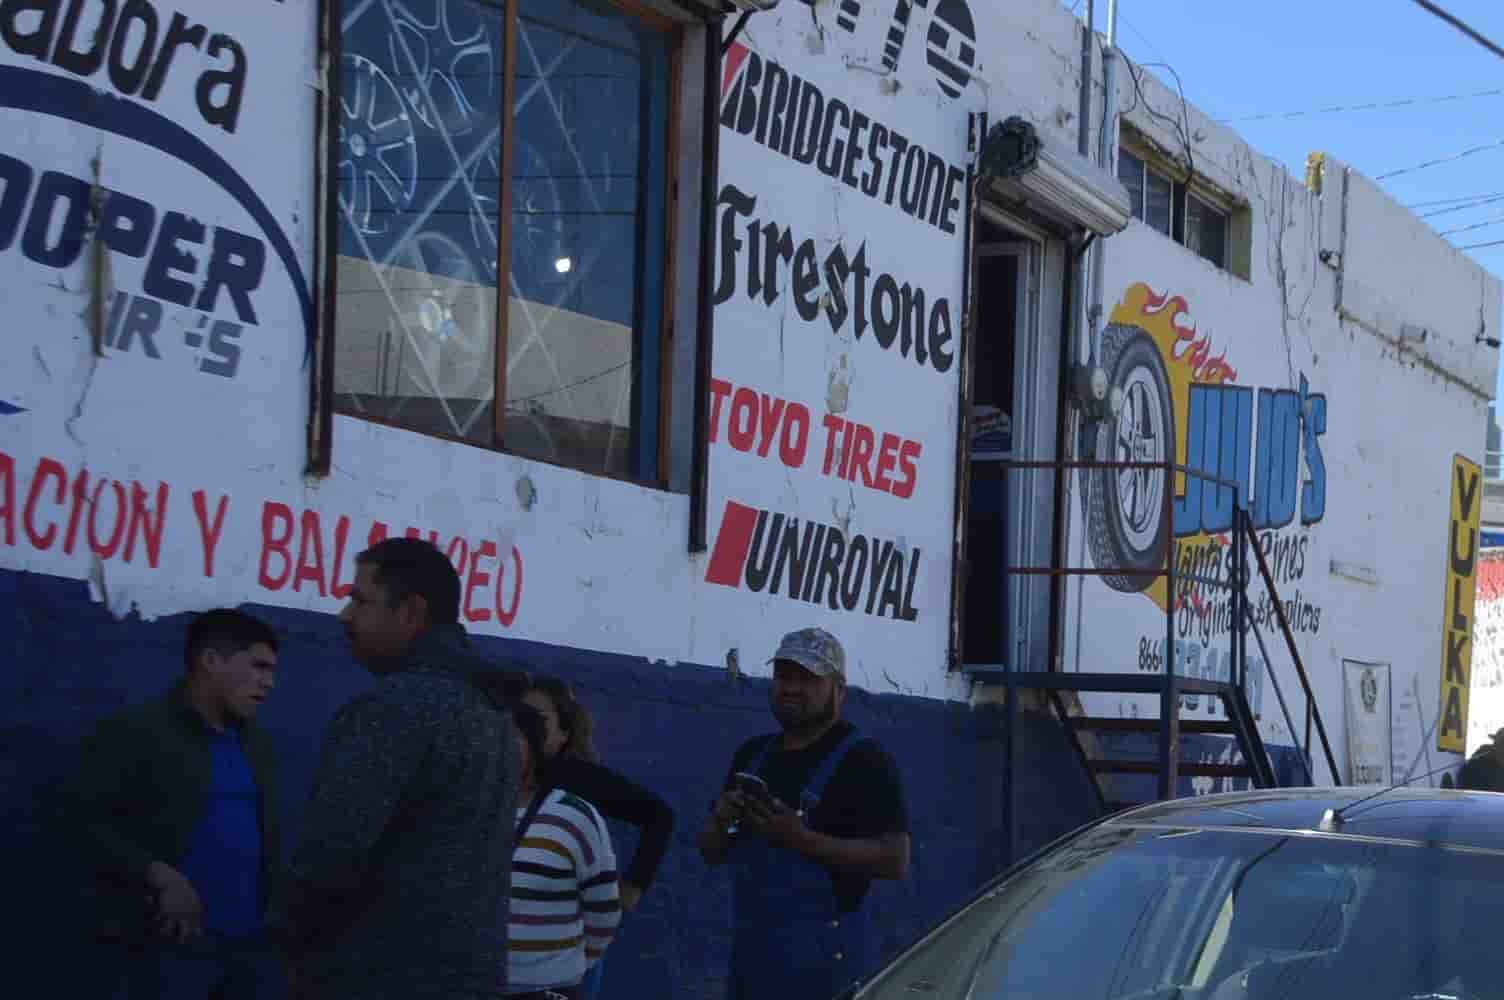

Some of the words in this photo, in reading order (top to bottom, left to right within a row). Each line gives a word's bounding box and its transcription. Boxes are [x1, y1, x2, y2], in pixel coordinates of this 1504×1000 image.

[720, 45, 966, 236] BRIDGESTONE
[712, 184, 954, 373] Firestone
[708, 378, 811, 480] TOYO
[822, 413, 923, 499] TIRES
[258, 501, 523, 627] BALEO
[745, 509, 922, 622] UNIROYAL
[1440, 464, 1479, 739] VULKA
